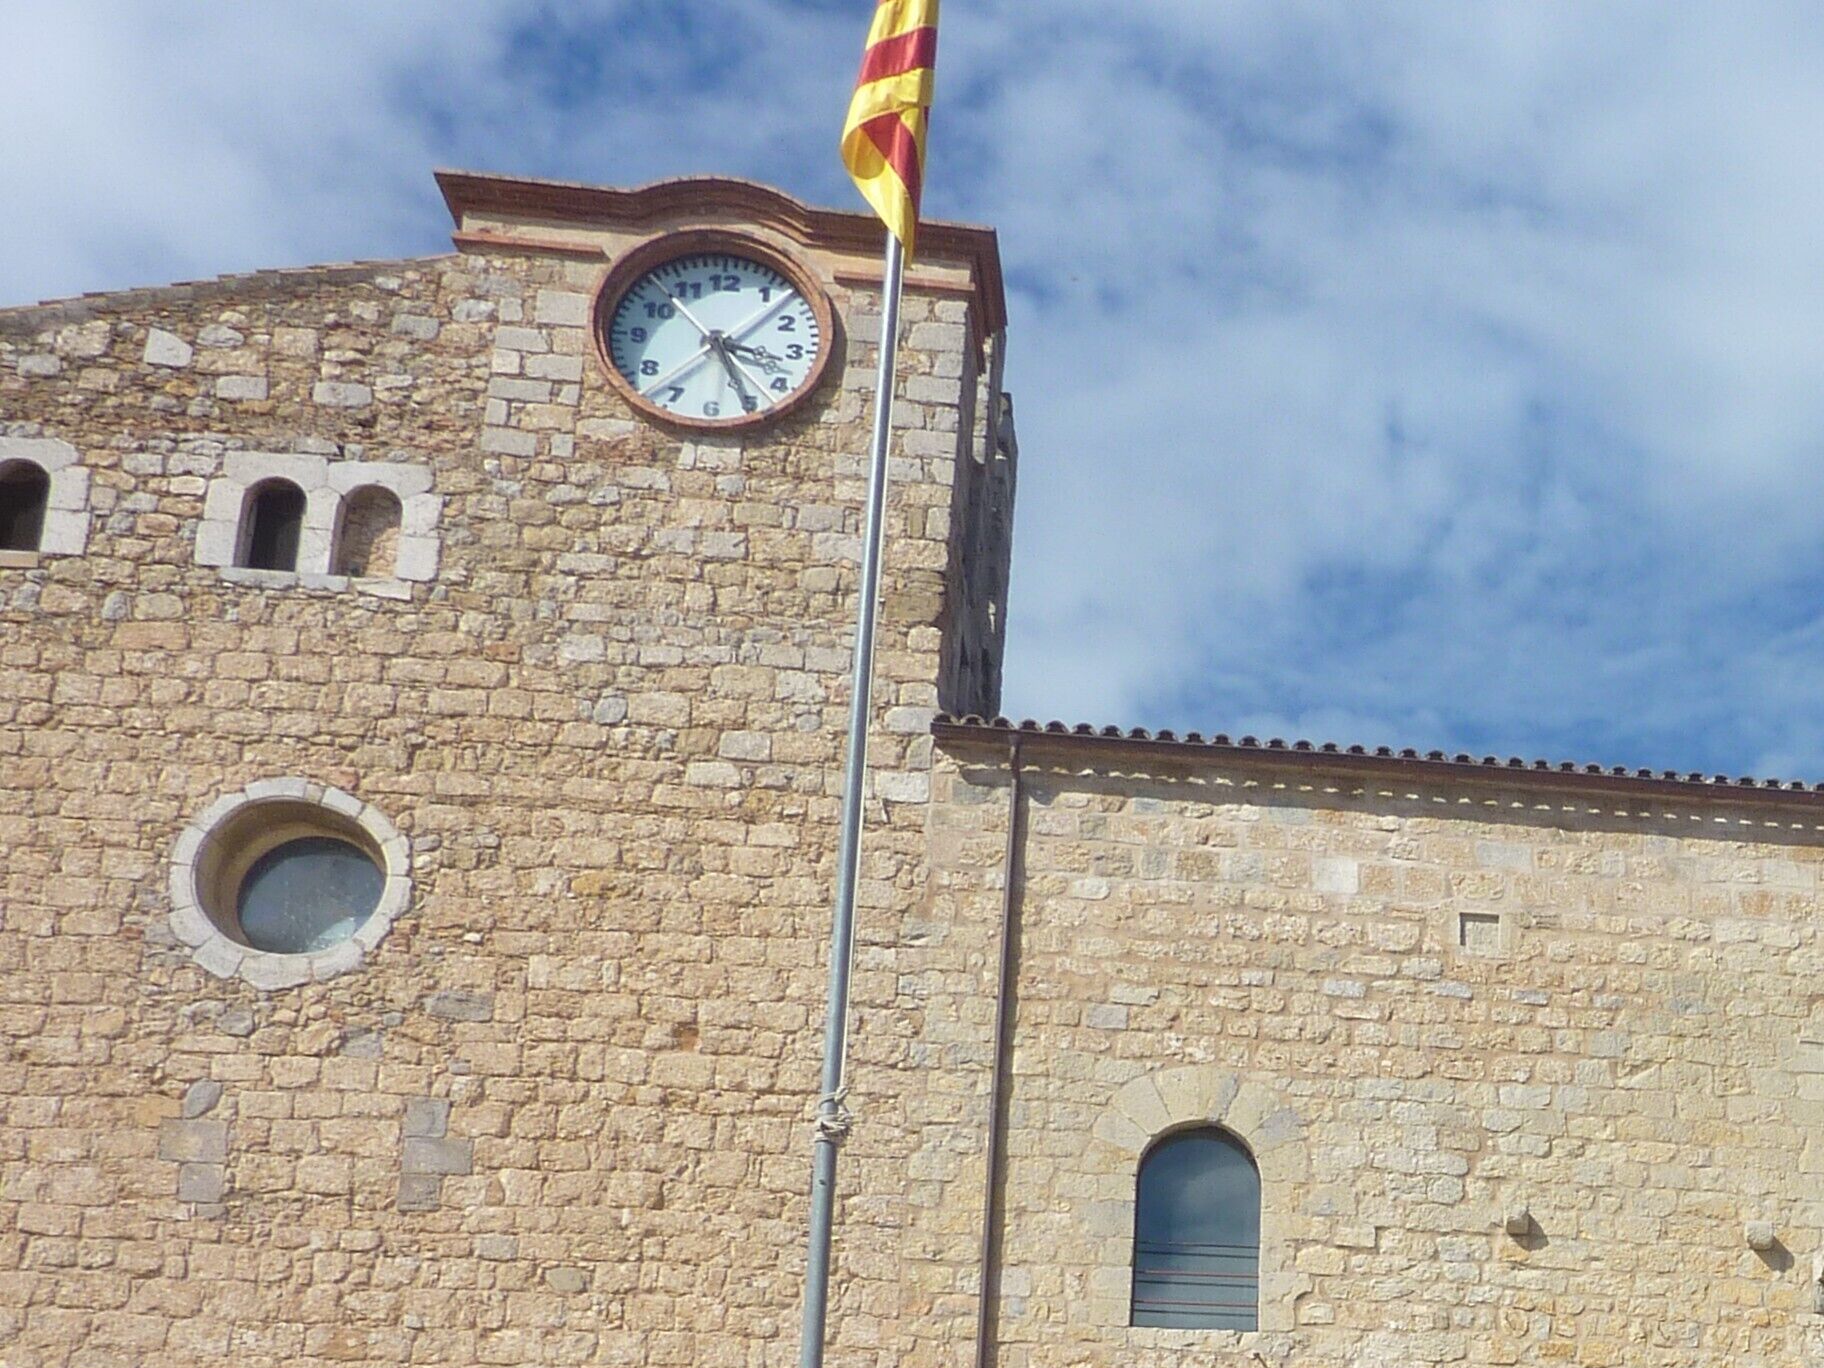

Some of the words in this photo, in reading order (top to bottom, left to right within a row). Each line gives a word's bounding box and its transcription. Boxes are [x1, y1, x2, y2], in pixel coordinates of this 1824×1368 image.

[675, 282, 701, 299] 11
[709, 275, 740, 292] 12
[759, 287, 770, 302] 1
[643, 303, 674, 319] 10
[778, 316, 796, 332] 2
[631, 327, 647, 343] 9
[786, 344, 803, 360] 3
[641, 360, 659, 376] 8
[770, 377, 788, 392] 4
[668, 387, 684, 402] 7
[703, 402, 719, 417] 6
